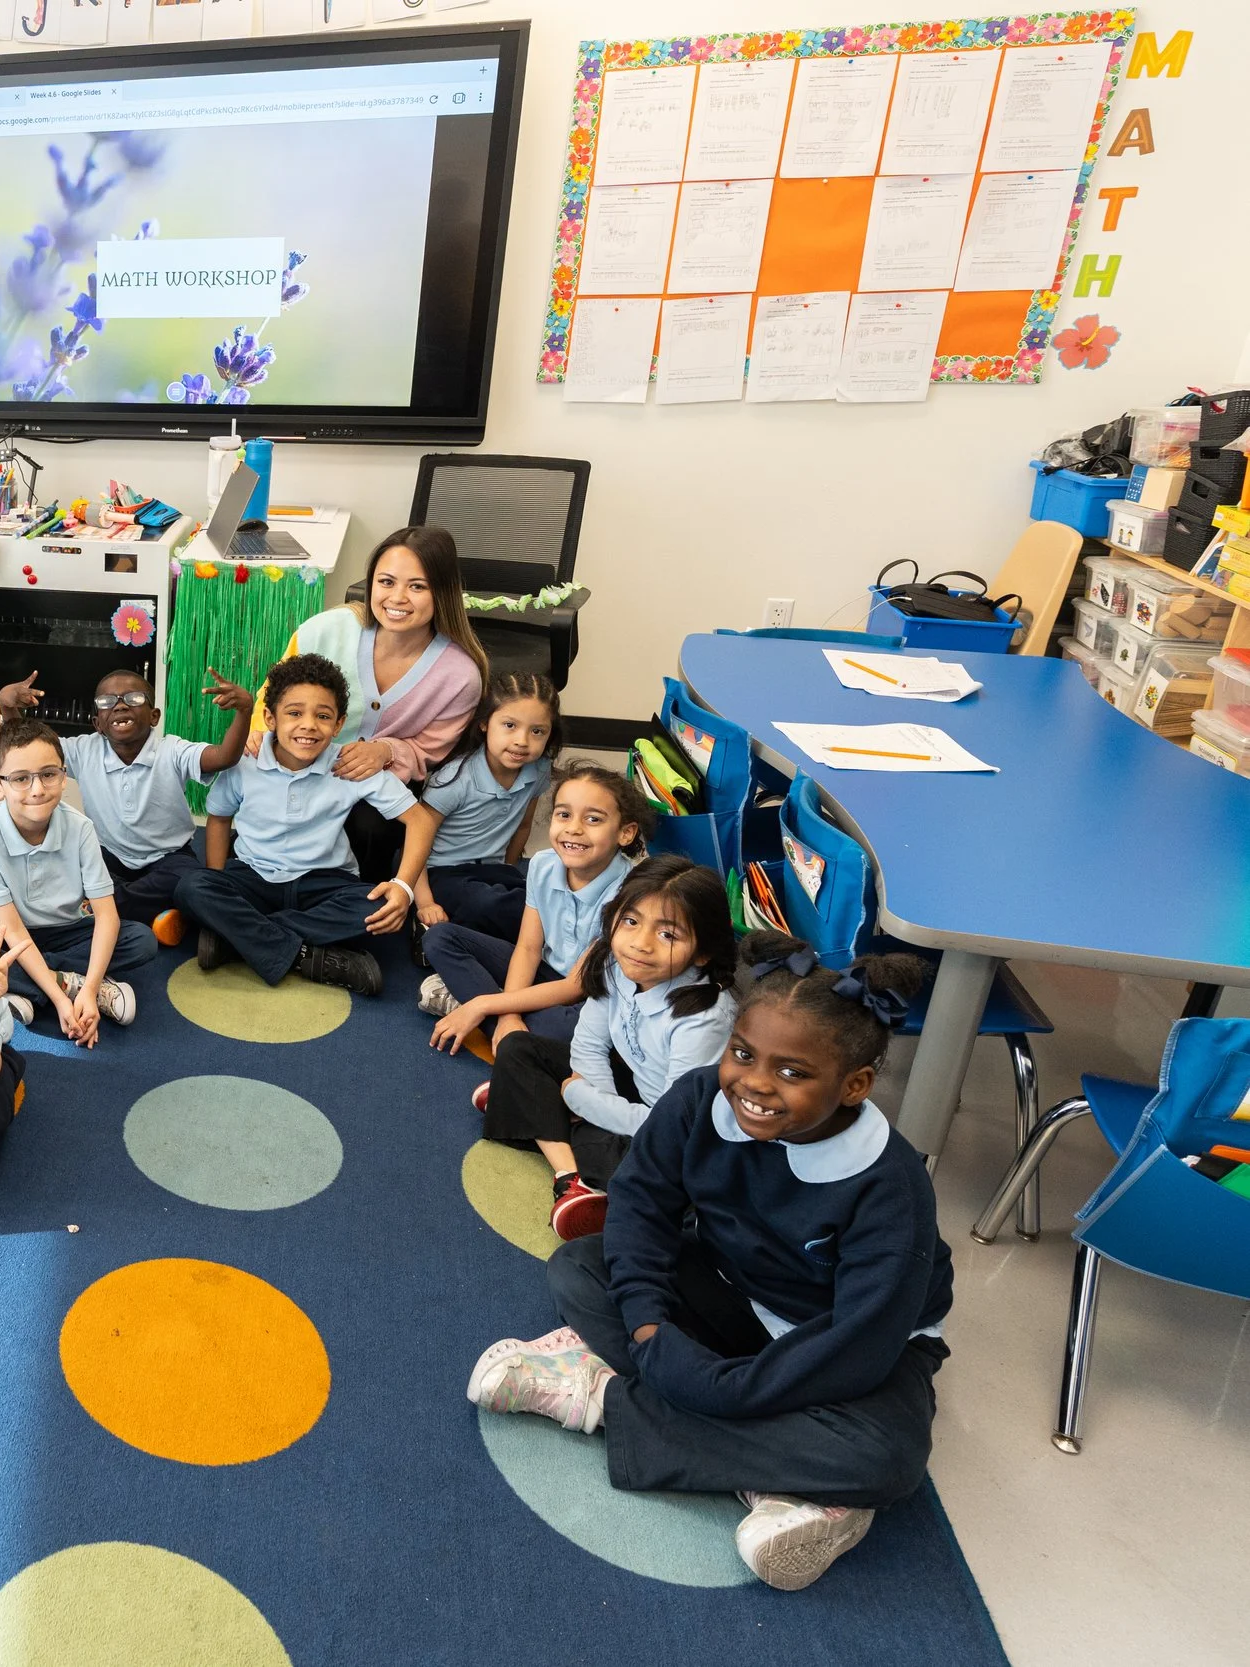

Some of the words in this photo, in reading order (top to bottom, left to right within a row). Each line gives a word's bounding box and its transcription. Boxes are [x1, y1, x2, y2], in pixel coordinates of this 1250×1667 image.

[61, 90, 83, 98] Google
[1072, 30, 1194, 298] MATH
[101, 271, 158, 287] MATH
[165, 269, 277, 288] WORKSHOP
